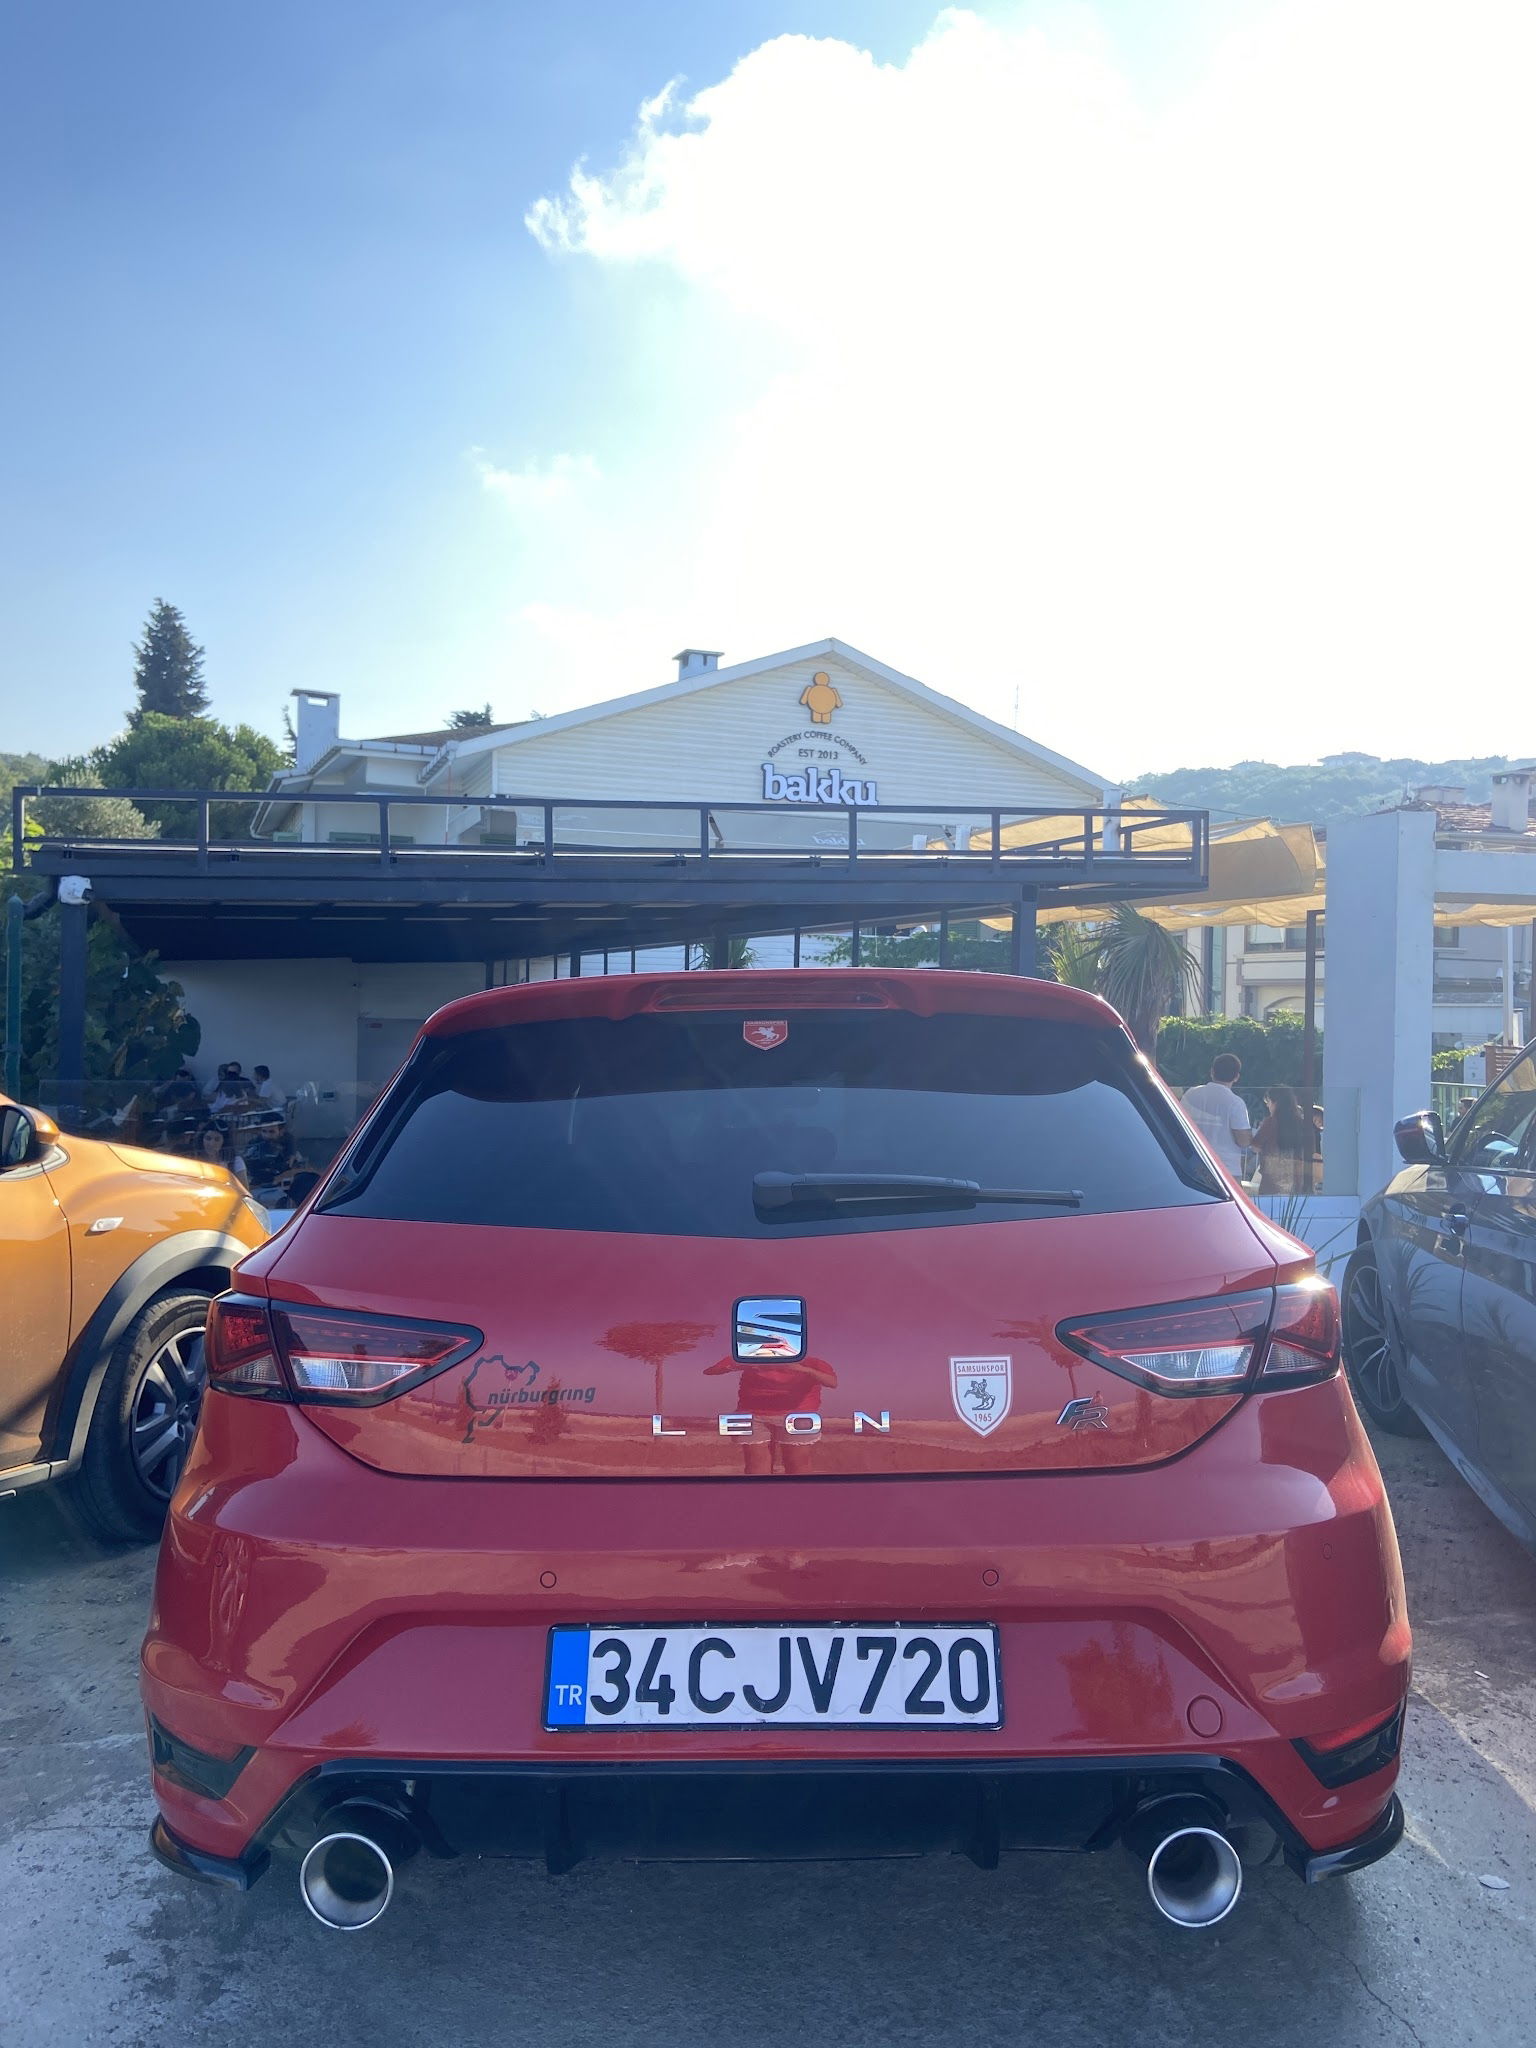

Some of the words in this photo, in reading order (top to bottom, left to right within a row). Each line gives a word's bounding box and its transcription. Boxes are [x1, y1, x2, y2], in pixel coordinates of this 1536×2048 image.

[768, 732, 802, 757] ROASTERY
[803, 731, 833, 741] COFFEE
[834, 736, 867, 764] COMPANY
[798, 748, 815, 758] EST
[817, 750, 838, 760] 2013
[761, 763, 879, 806] bakku
[957, 1365, 1005, 1373] SAMSUNSPOR
[652, 1411, 890, 1436] LEON
[974, 1413, 992, 1422] 1965
[1056, 1397, 1108, 1431] FR
[555, 1685, 582, 1706] TR
